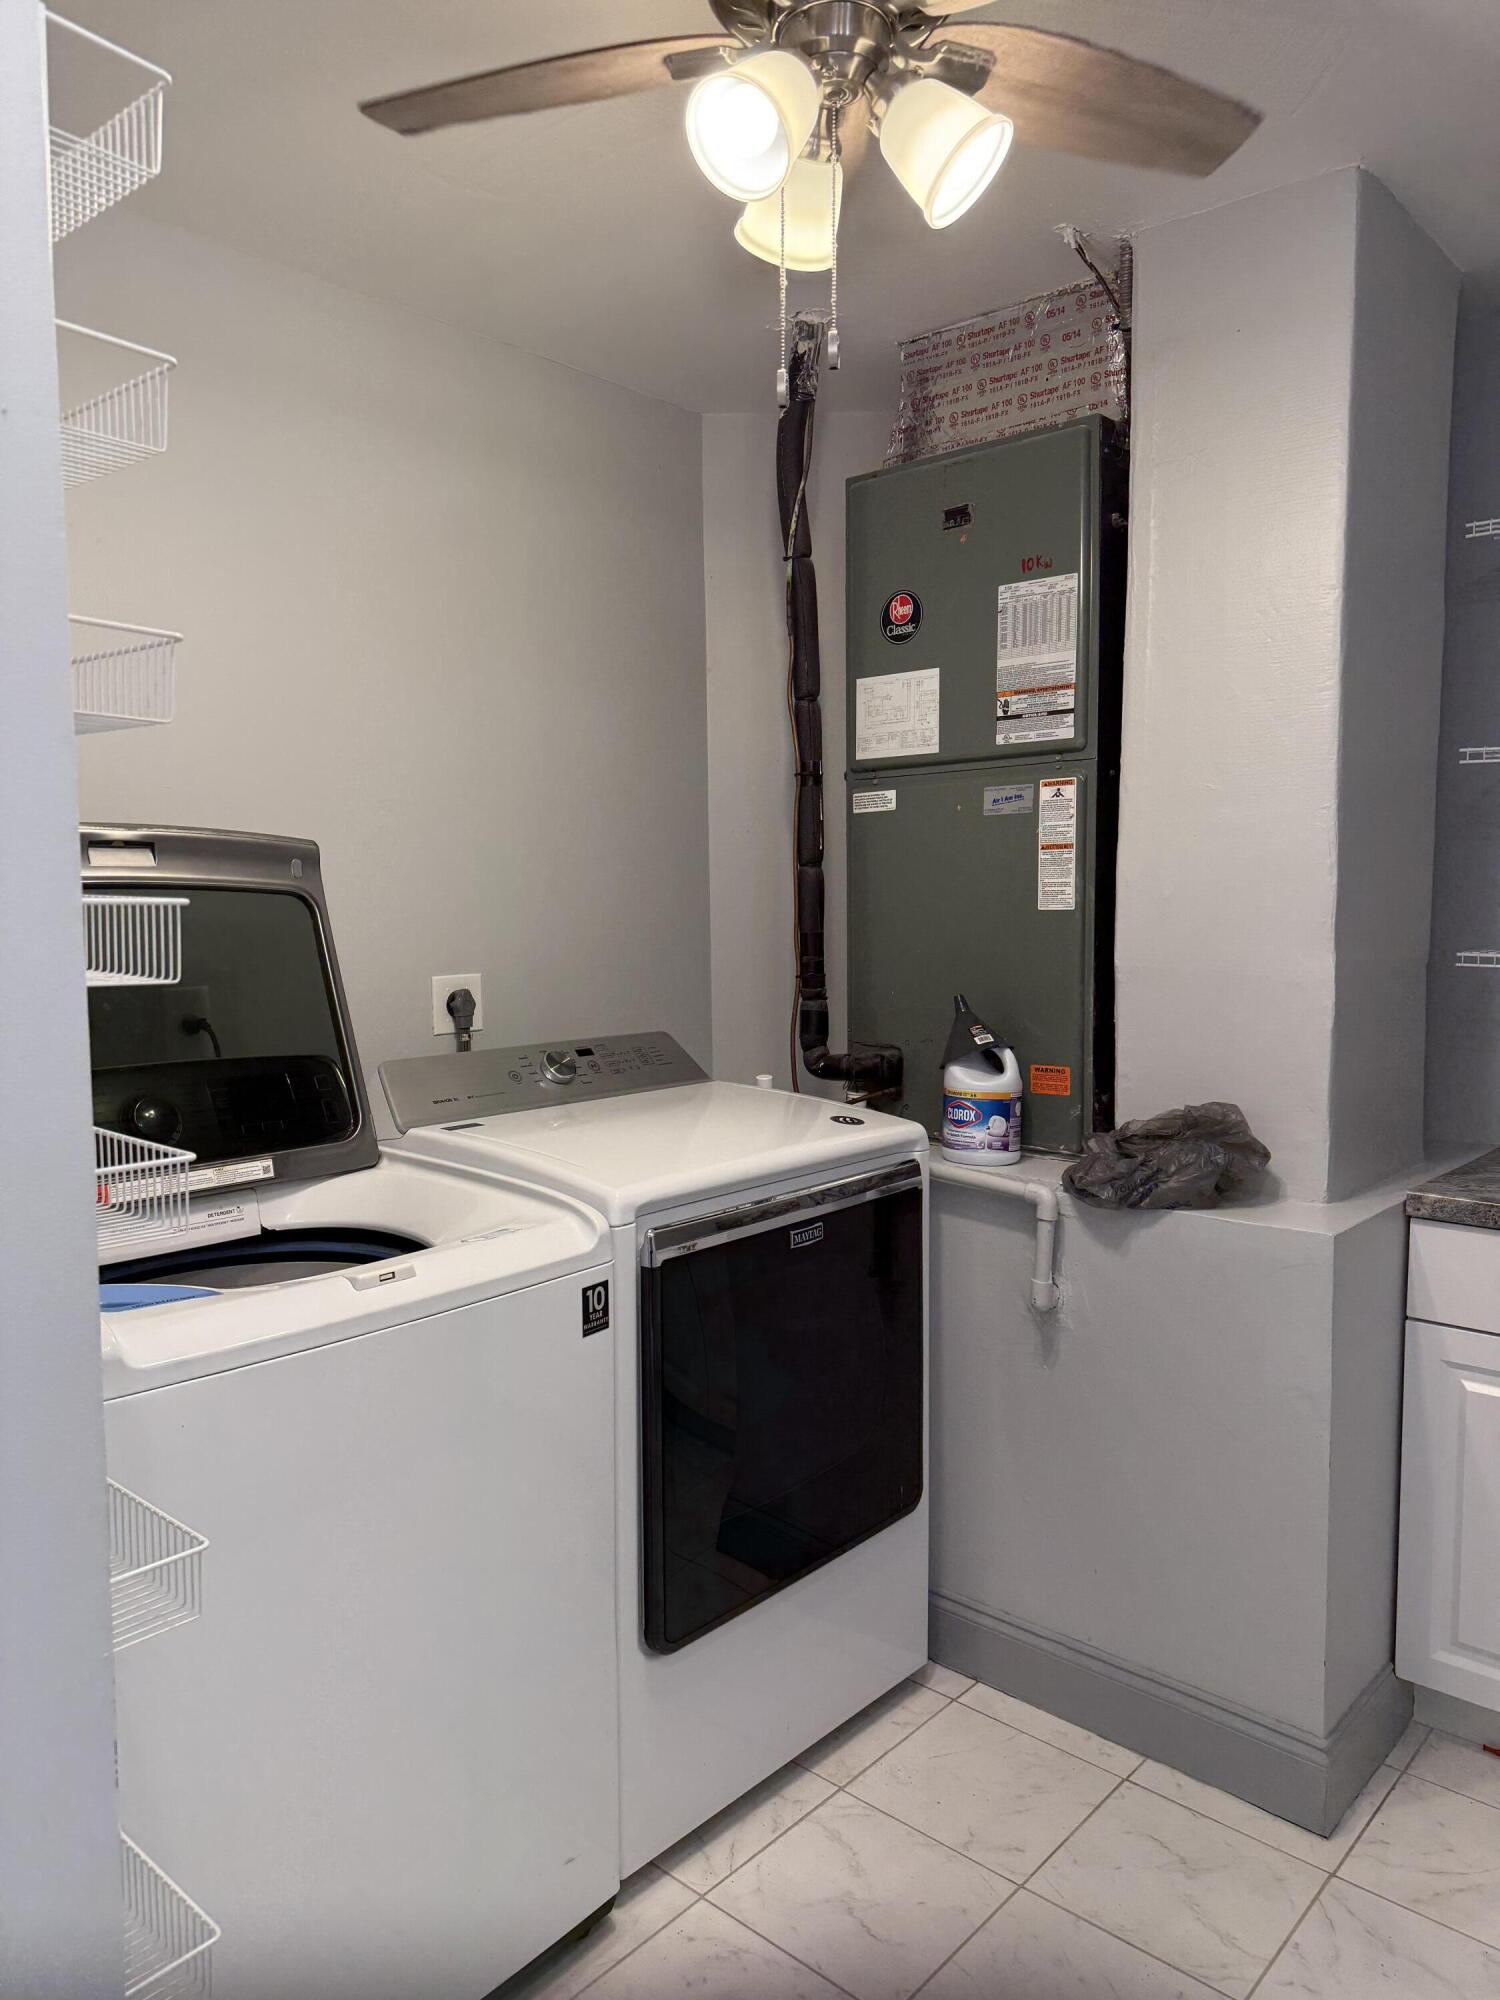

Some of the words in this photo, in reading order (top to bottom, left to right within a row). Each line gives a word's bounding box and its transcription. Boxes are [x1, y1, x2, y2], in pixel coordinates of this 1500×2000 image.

[967, 326, 995, 341] Shurtape
[998, 320, 1008, 330] AF
[1013, 342, 1023, 352] AF
[1062, 328, 1082, 343] 05/14
[952, 386, 961, 396] AF
[961, 382, 973, 393] 100
[989, 371, 1018, 386] Shurtape
[1020, 366, 1031, 377] AF
[1031, 362, 1044, 373] 100
[1060, 349, 1091, 365] Shurtape
[1094, 345, 1105, 356] AF
[960, 405, 988, 419] Shurtape
[991, 401, 1001, 411] AF
[1001, 397, 1013, 408] 100
[1030, 385, 1060, 400] Shurtape
[1062, 380, 1072, 390] AF
[1073, 376, 1086, 388] 100
[887, 622, 916, 637] Classic
[1034, 1066, 1066, 1075] WARNING
[947, 1107, 976, 1122] CLOROX
[207, 1207, 237, 1219] DETERGENT
[793, 1226, 823, 1245] MAYTAG
[585, 1285, 606, 1314] 10
